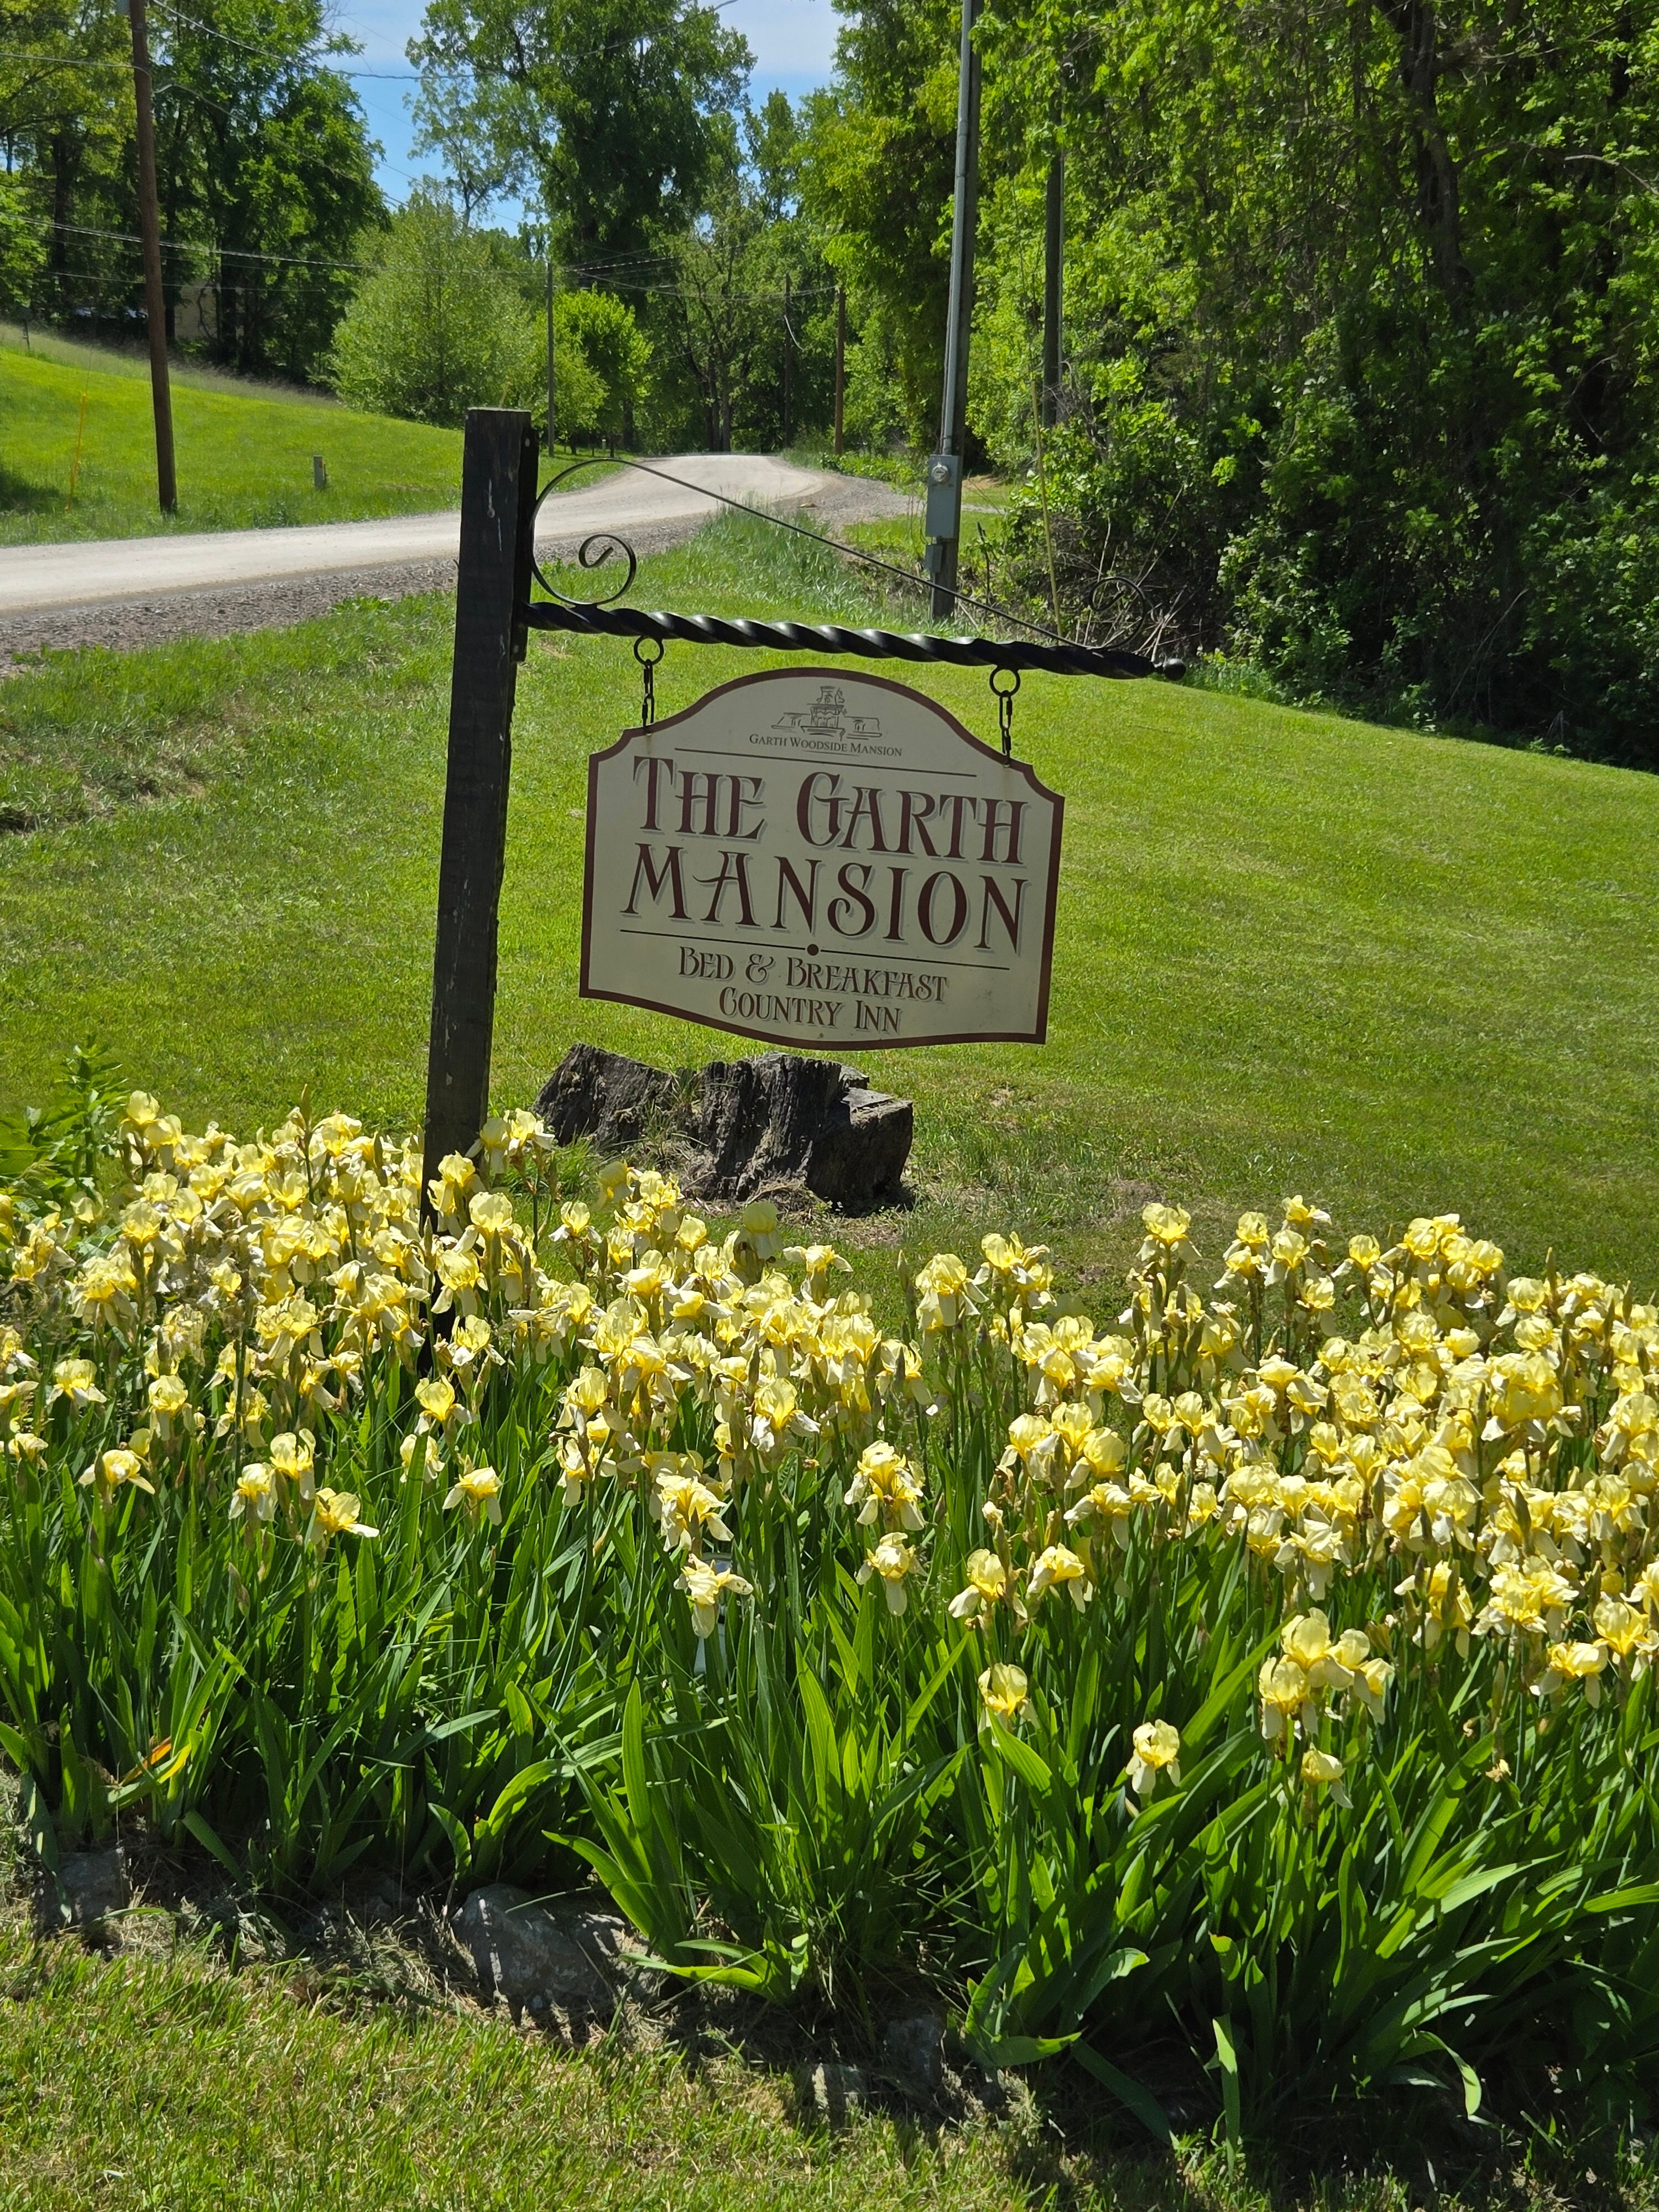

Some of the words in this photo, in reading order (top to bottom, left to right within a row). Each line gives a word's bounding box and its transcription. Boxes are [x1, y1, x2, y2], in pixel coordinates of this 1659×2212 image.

[749, 734, 787, 747] GARTH
[790, 737, 847, 752] WOODSIDE
[851, 743, 902, 757] MANSION
[633, 756, 766, 839] THE
[797, 771, 1029, 865] GARTH
[620, 843, 1029, 954] MANSION
[679, 946, 734, 979] BED
[745, 953, 774, 983] &
[786, 957, 948, 1001] BREAKFAST
[719, 987, 843, 1026] COUNTRY
[854, 1000, 901, 1033] INN
